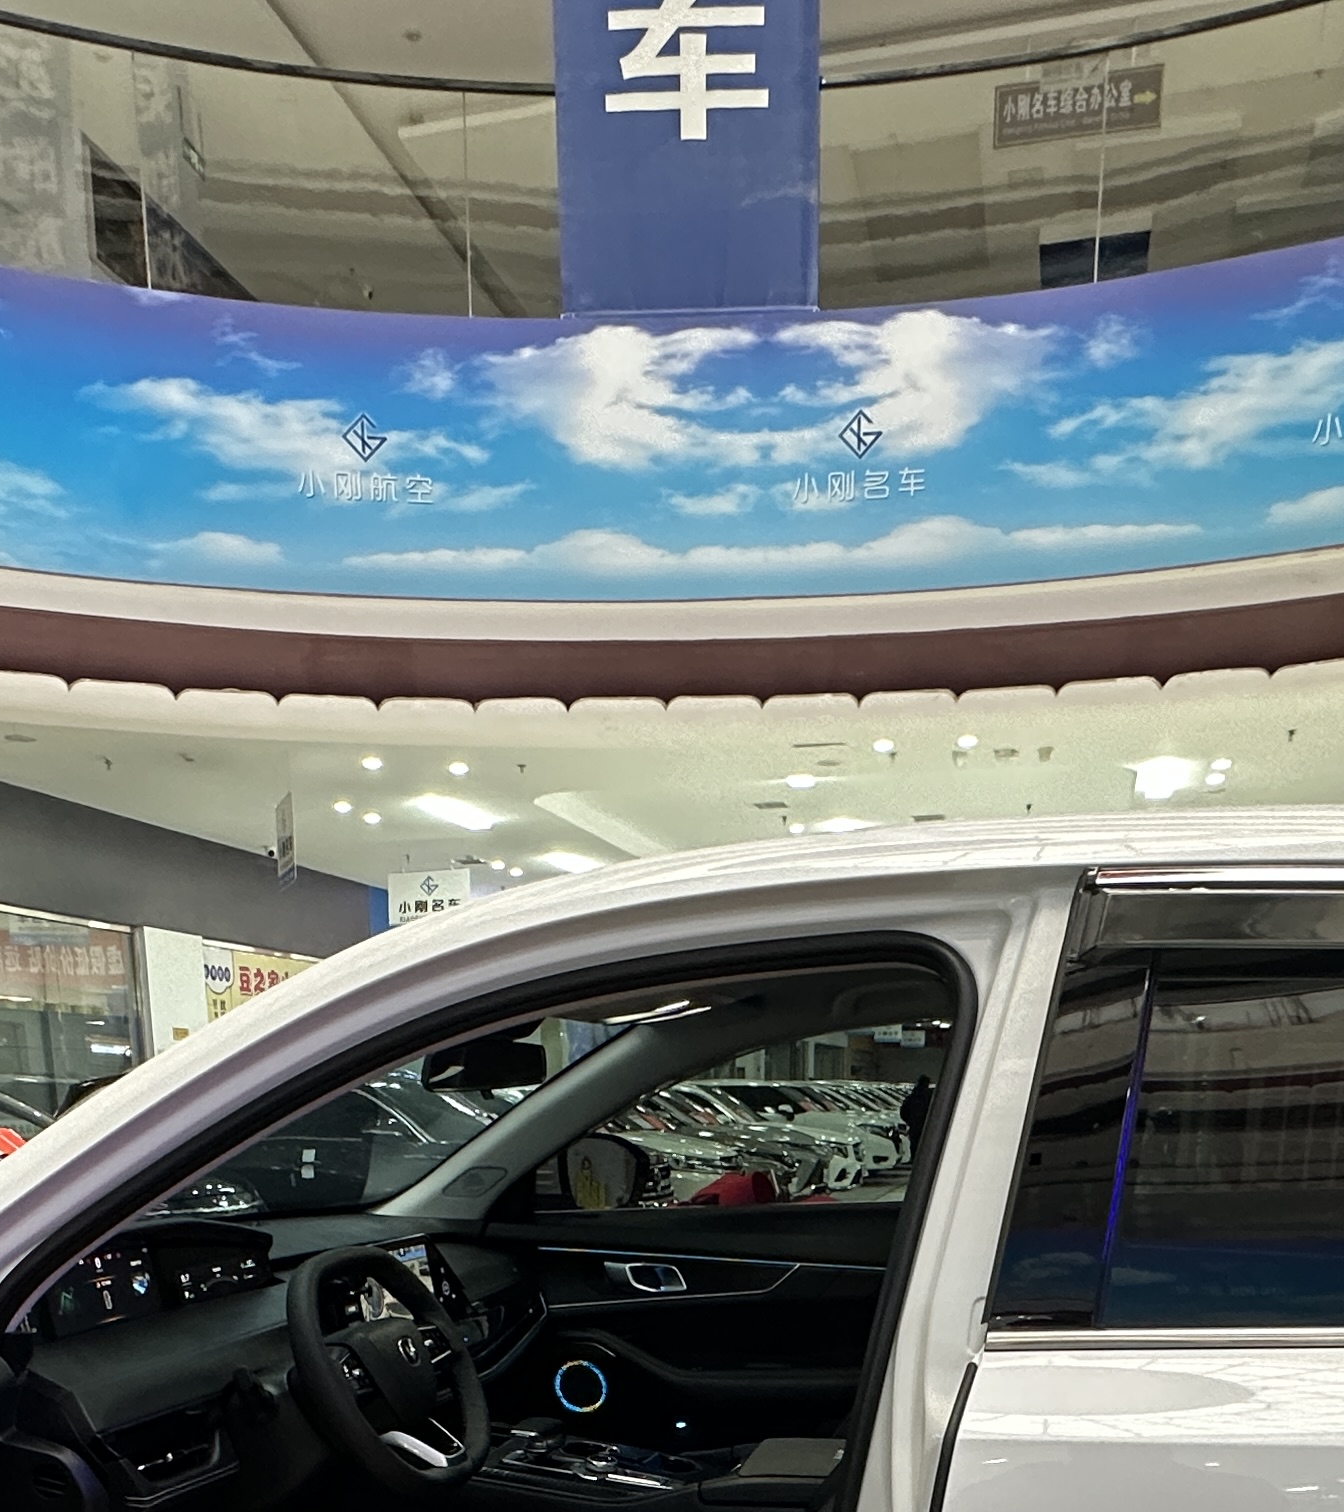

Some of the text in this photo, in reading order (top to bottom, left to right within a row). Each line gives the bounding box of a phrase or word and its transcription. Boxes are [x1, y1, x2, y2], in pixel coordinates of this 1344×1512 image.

[605, 0, 769, 141] 车
[1003, 79, 1133, 123] 小刚名车综合办公室
[297, 469, 435, 505] 小刚航空
[792, 466, 926, 505] 小刚名车
[398, 897, 462, 914] 小刚名车
